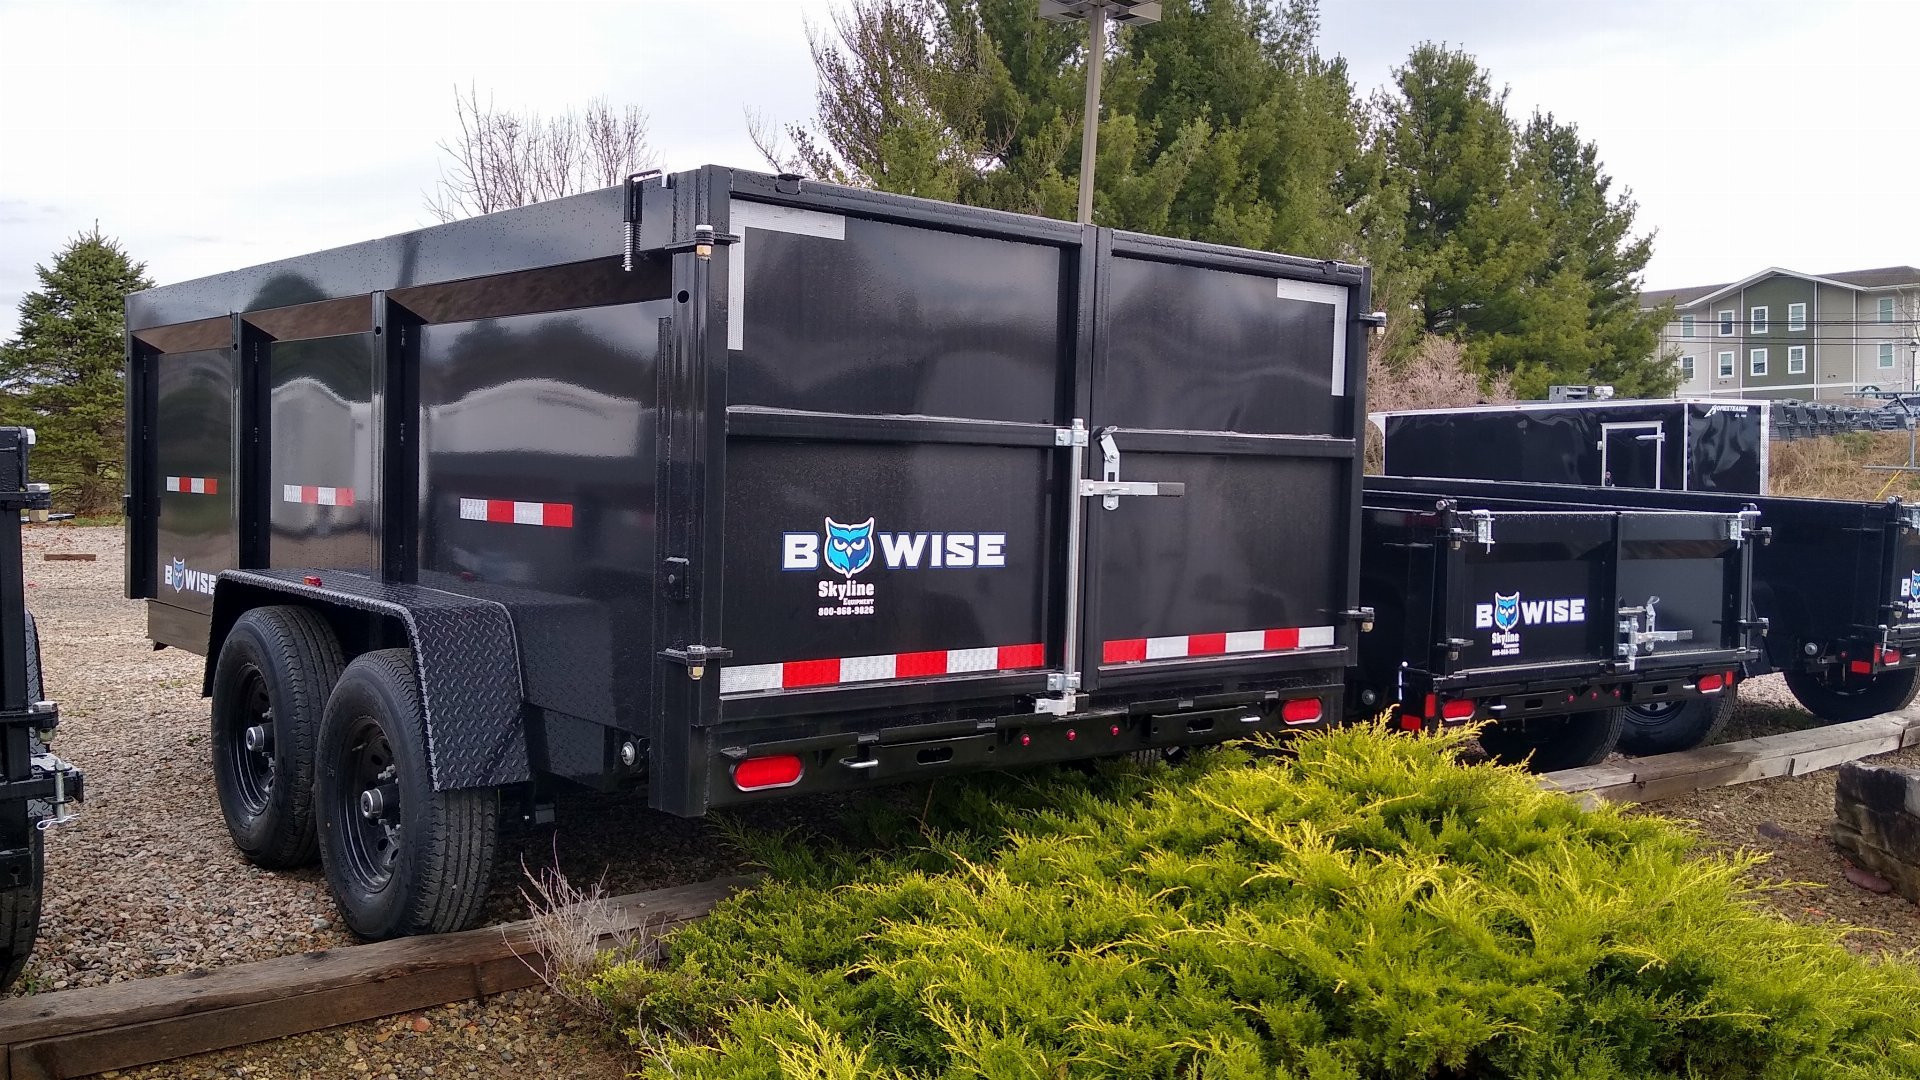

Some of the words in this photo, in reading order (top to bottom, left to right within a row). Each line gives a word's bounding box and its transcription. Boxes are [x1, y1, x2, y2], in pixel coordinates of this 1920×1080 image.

[818, 580, 875, 601] Skyline
[818, 606, 875, 617] 800-868-9826
[1491, 631, 1520, 646] Skyline
